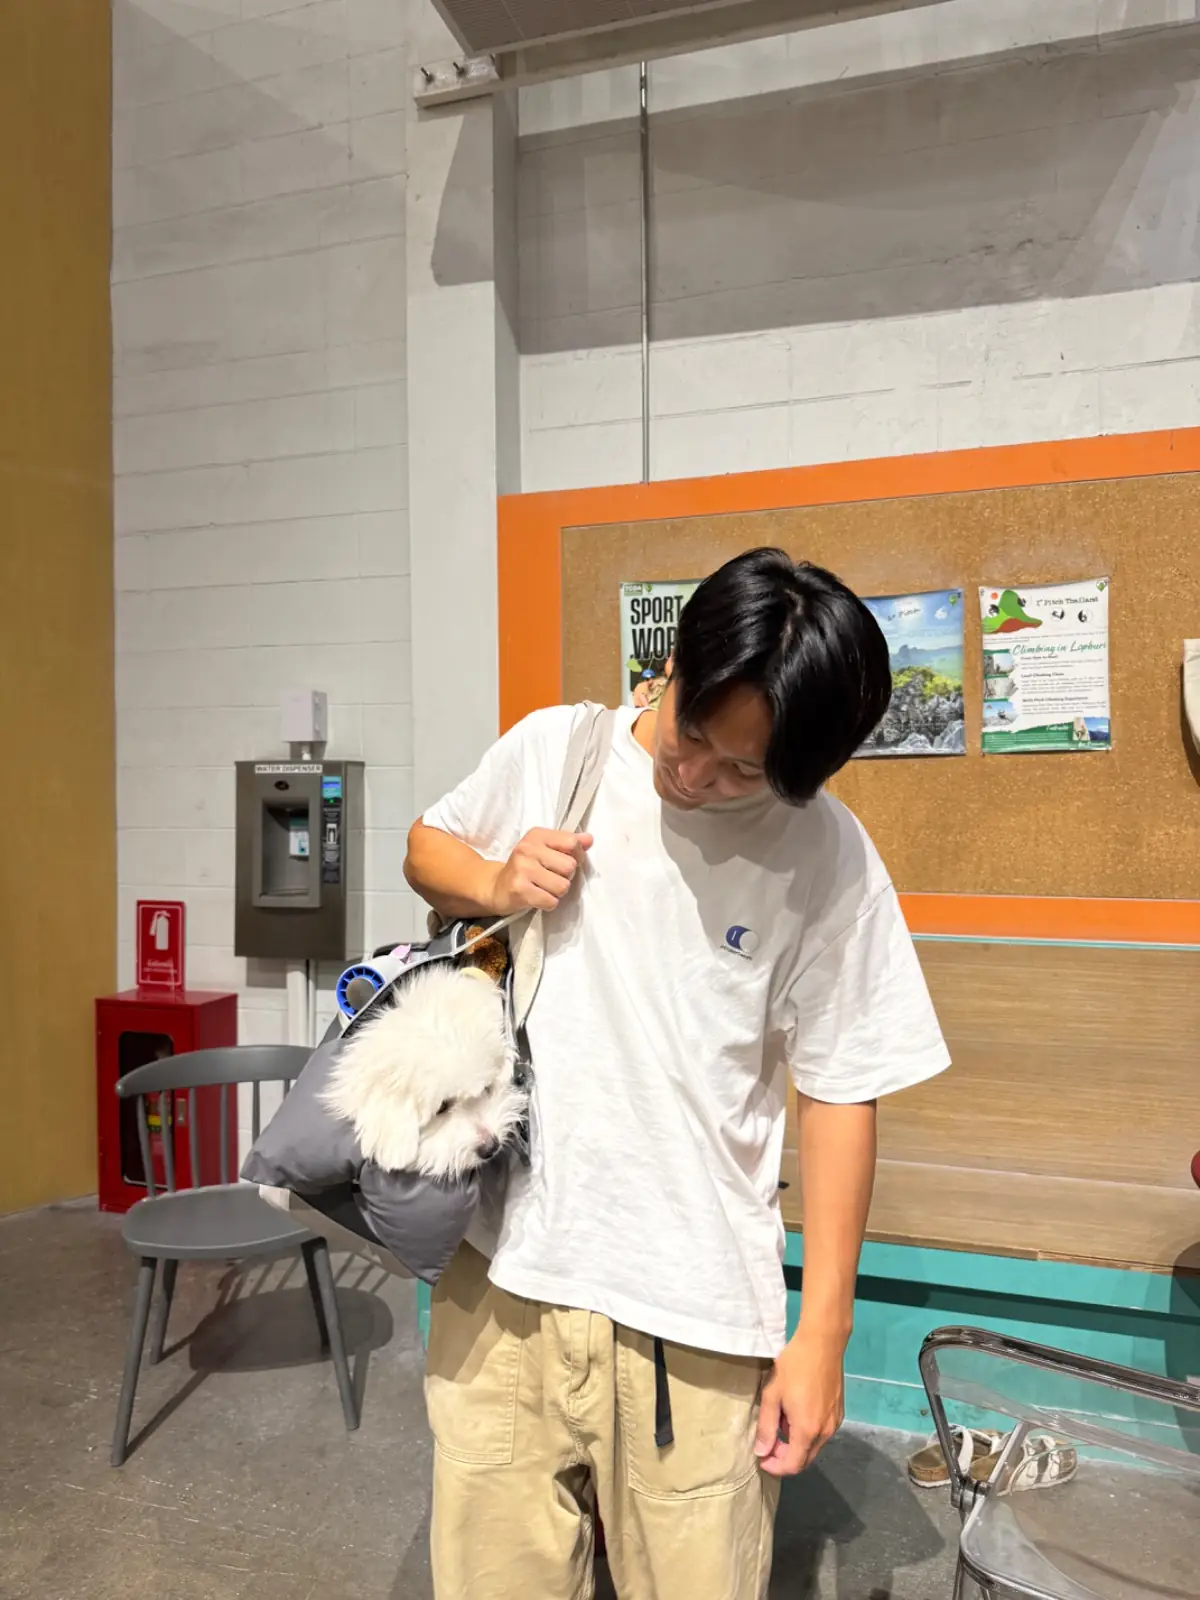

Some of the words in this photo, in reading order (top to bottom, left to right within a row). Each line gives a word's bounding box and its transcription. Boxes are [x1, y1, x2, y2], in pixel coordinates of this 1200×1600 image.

[1065, 596, 1099, 604] Thailand
[630, 594, 684, 625] SPORT
[1012, 643, 1056, 656] Climbing
[1070, 640, 1107, 653] Lopburi
